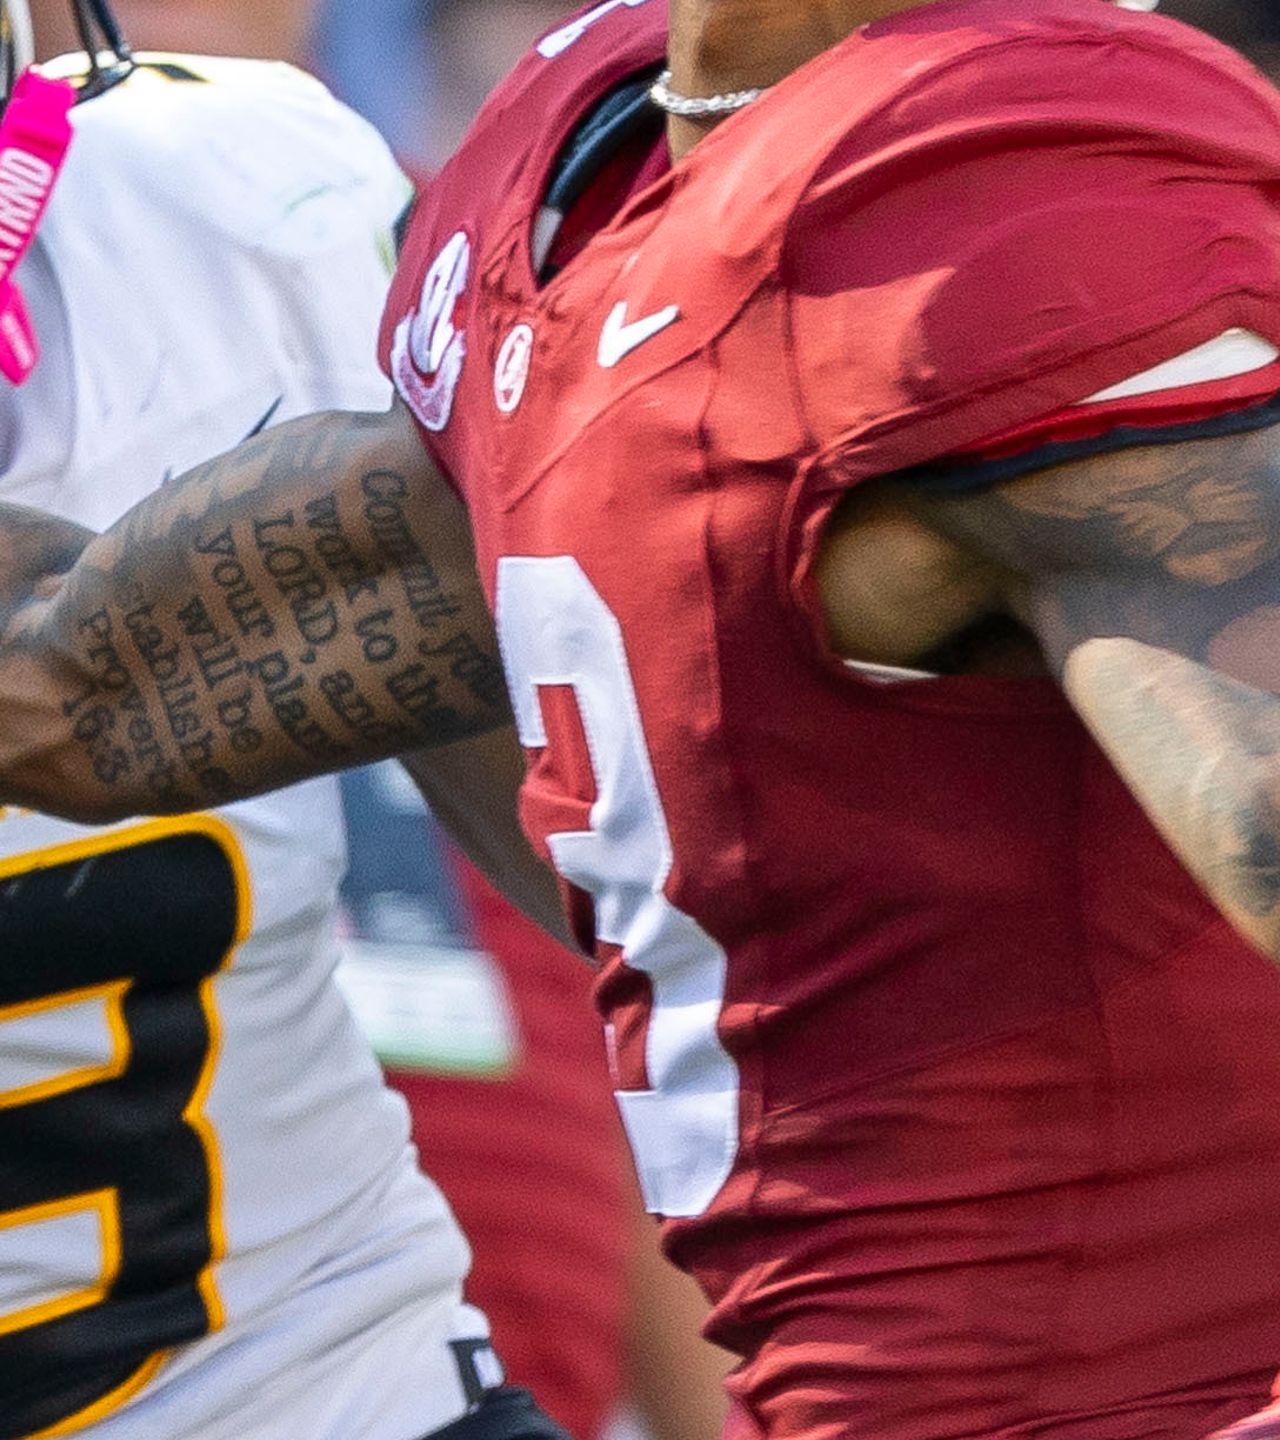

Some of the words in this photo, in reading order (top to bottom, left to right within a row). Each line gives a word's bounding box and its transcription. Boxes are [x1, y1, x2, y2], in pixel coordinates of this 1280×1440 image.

[192, 524, 275, 635] your
[251, 510, 341, 665] LORD,
[304, 493, 386, 603] work
[354, 608, 396, 660] to
[362, 465, 461, 630] Commit
[176, 594, 245, 689] will
[216, 691, 265, 754] be
